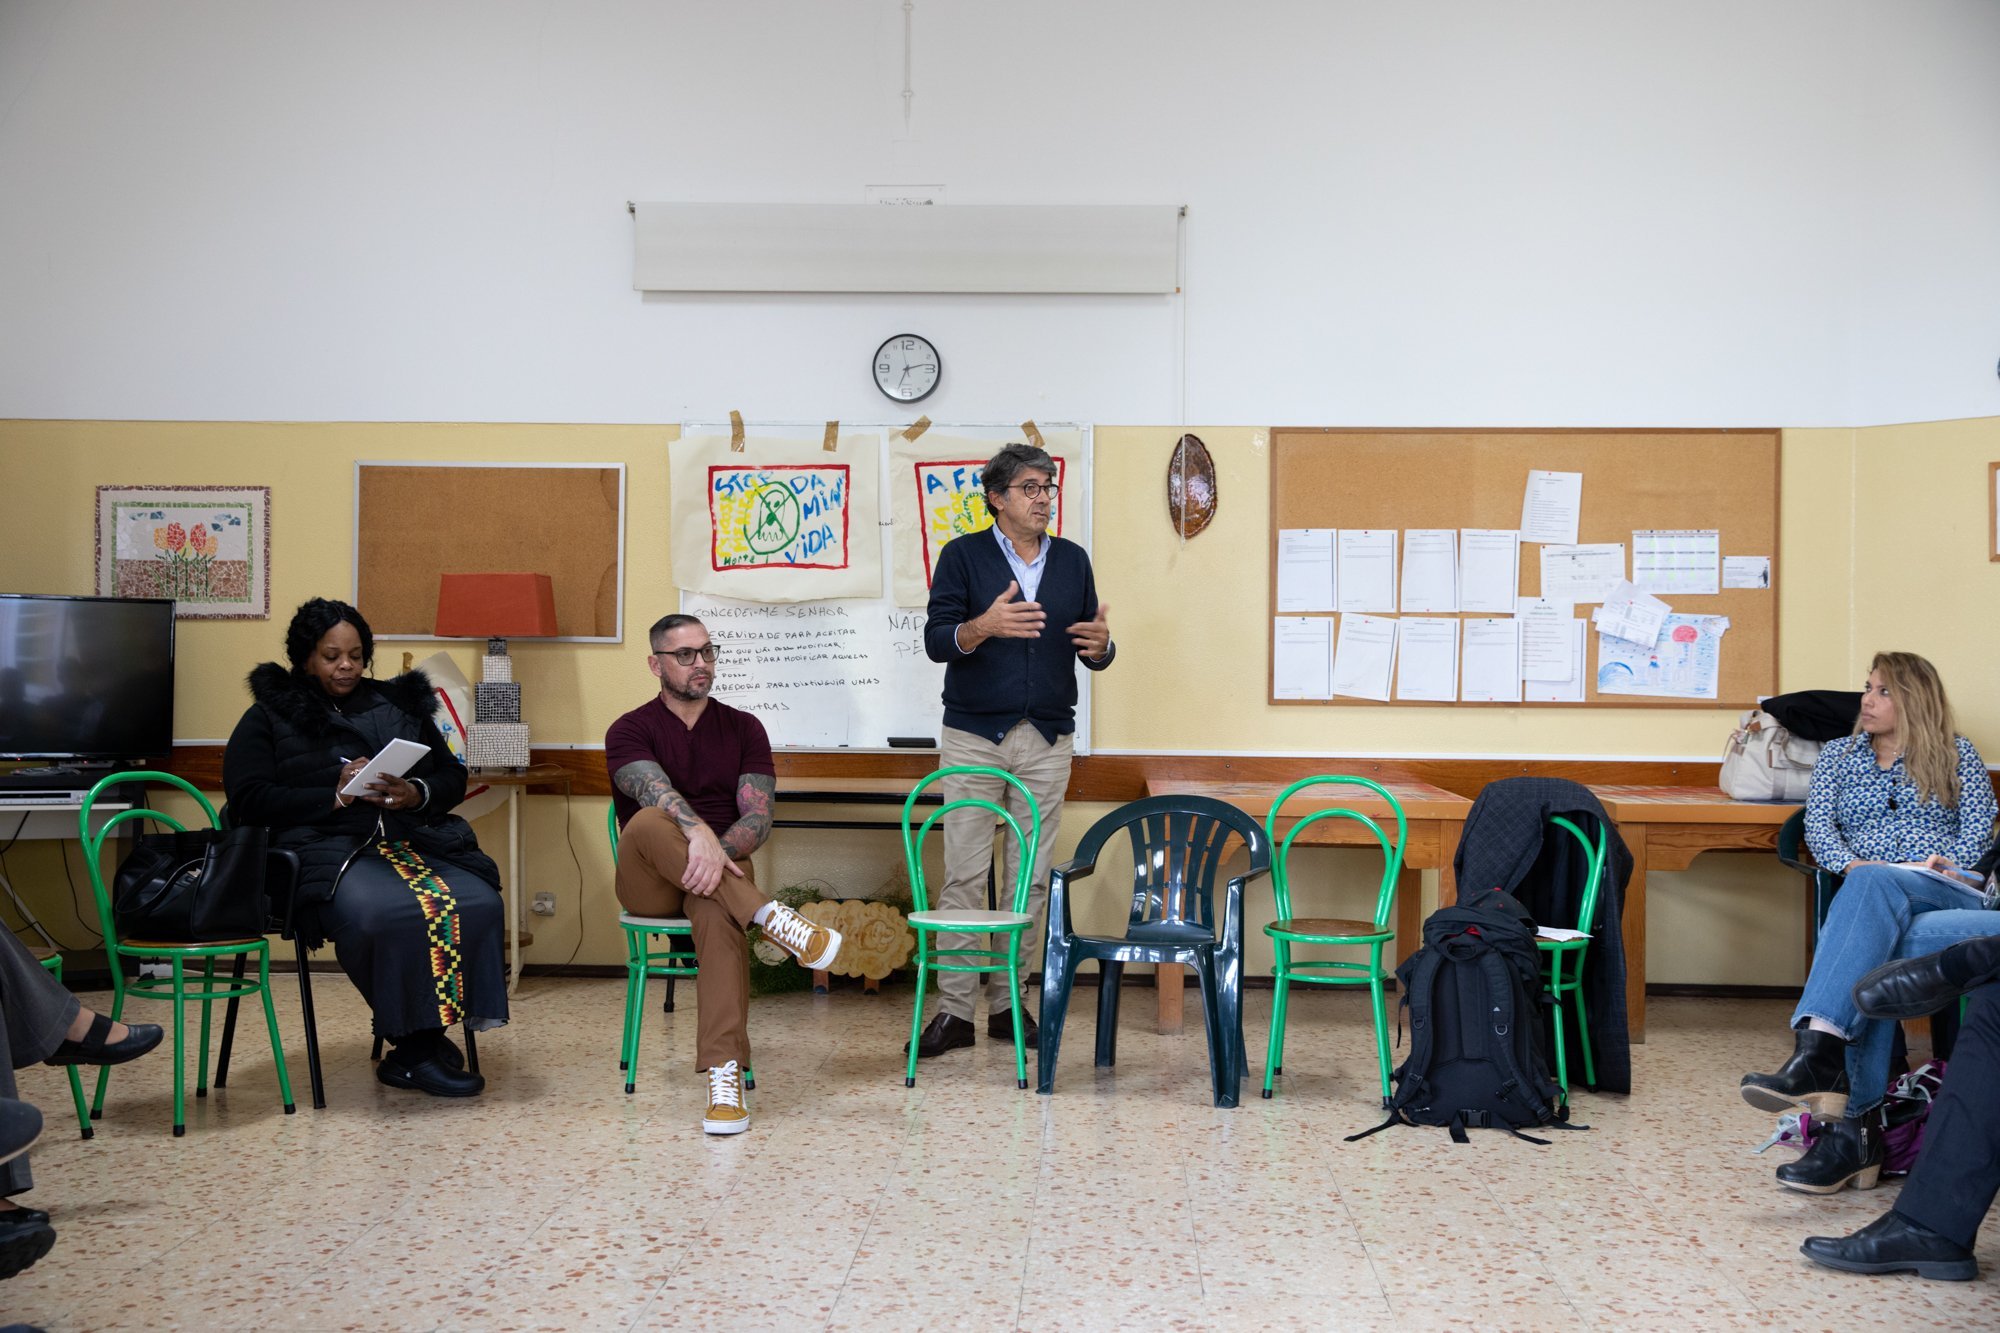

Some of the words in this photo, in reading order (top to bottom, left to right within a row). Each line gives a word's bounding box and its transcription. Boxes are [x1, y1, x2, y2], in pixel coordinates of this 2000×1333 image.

[901, 340, 915, 351] 12
[879, 363, 890, 374] 9
[924, 363, 936, 374] 3
[901, 387, 913, 397] 6
[790, 474, 826, 494] DA
[785, 605, 849, 618] SENHOR
[785, 630, 812, 640] PARA
[757, 655, 781, 664] PARA
[765, 681, 790, 690] PARA
